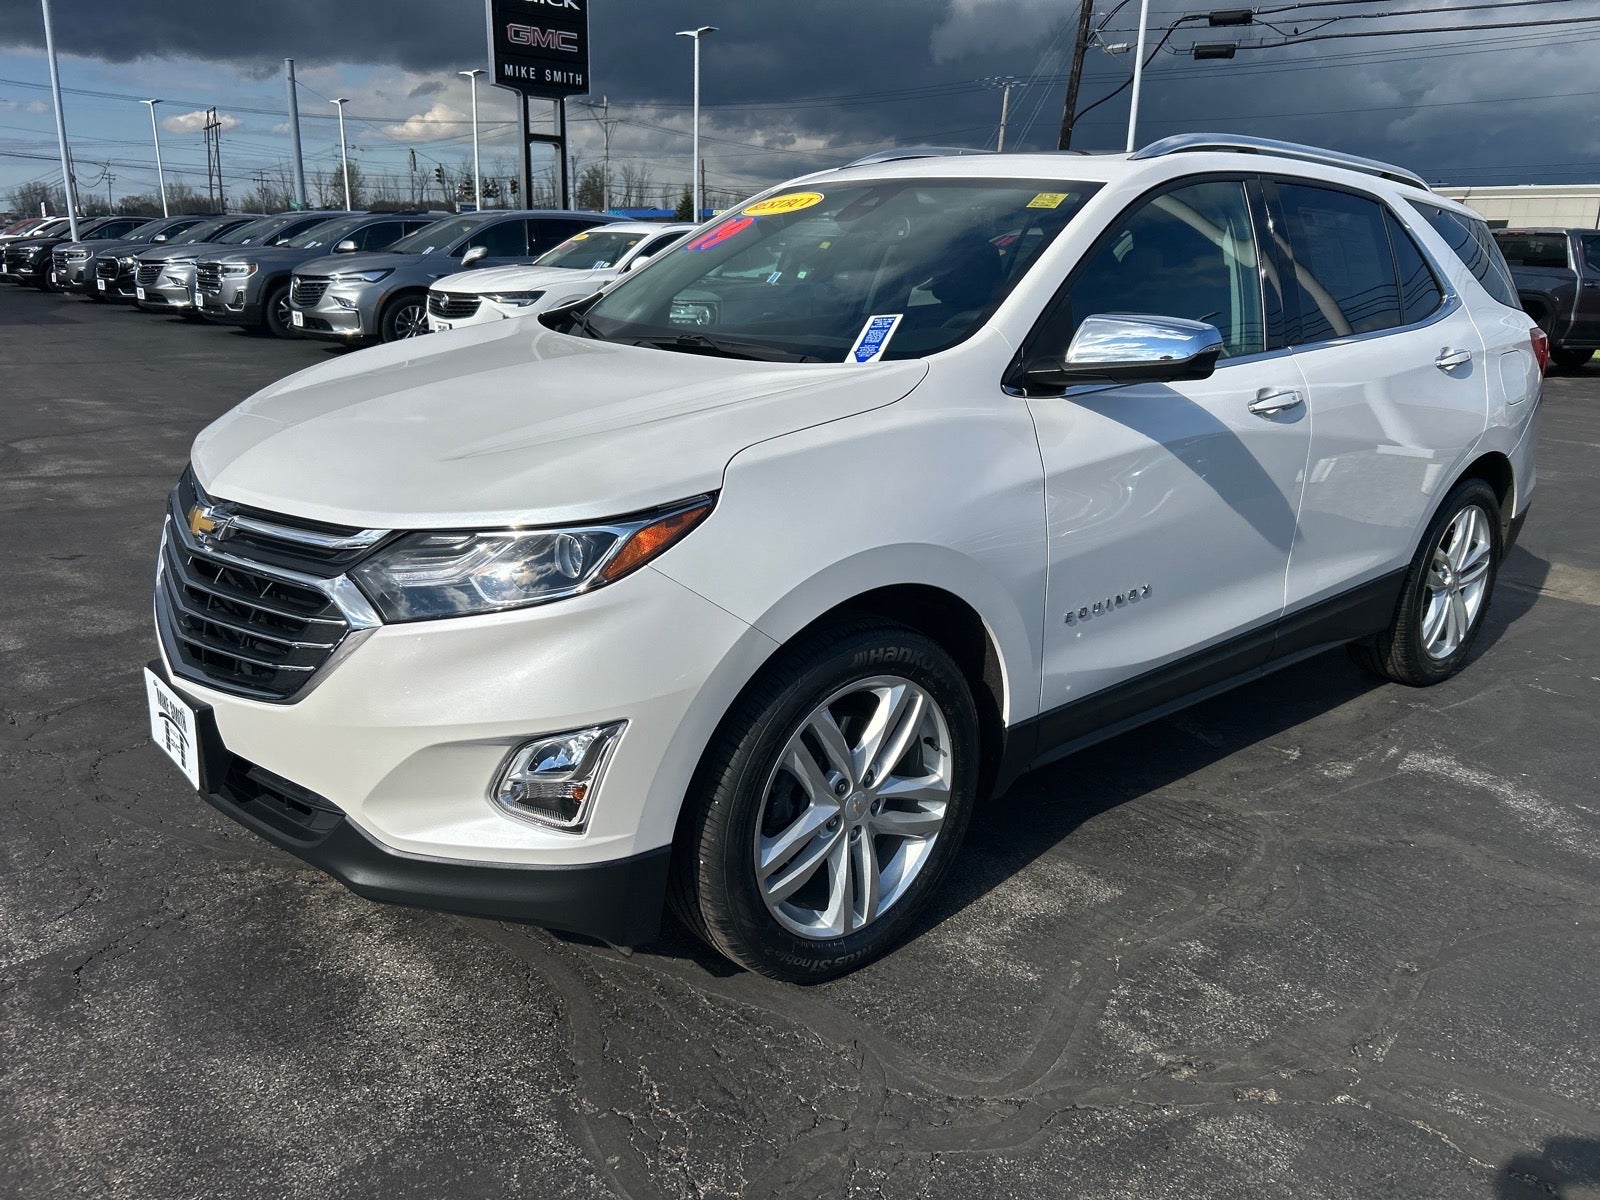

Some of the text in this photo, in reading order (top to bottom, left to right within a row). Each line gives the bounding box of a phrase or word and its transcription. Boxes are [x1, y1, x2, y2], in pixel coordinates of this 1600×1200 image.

[506, 23, 578, 53] GMC
[504, 64, 583, 86] MIKE SMITH
[1064, 584, 1151, 625] EQUINOX
